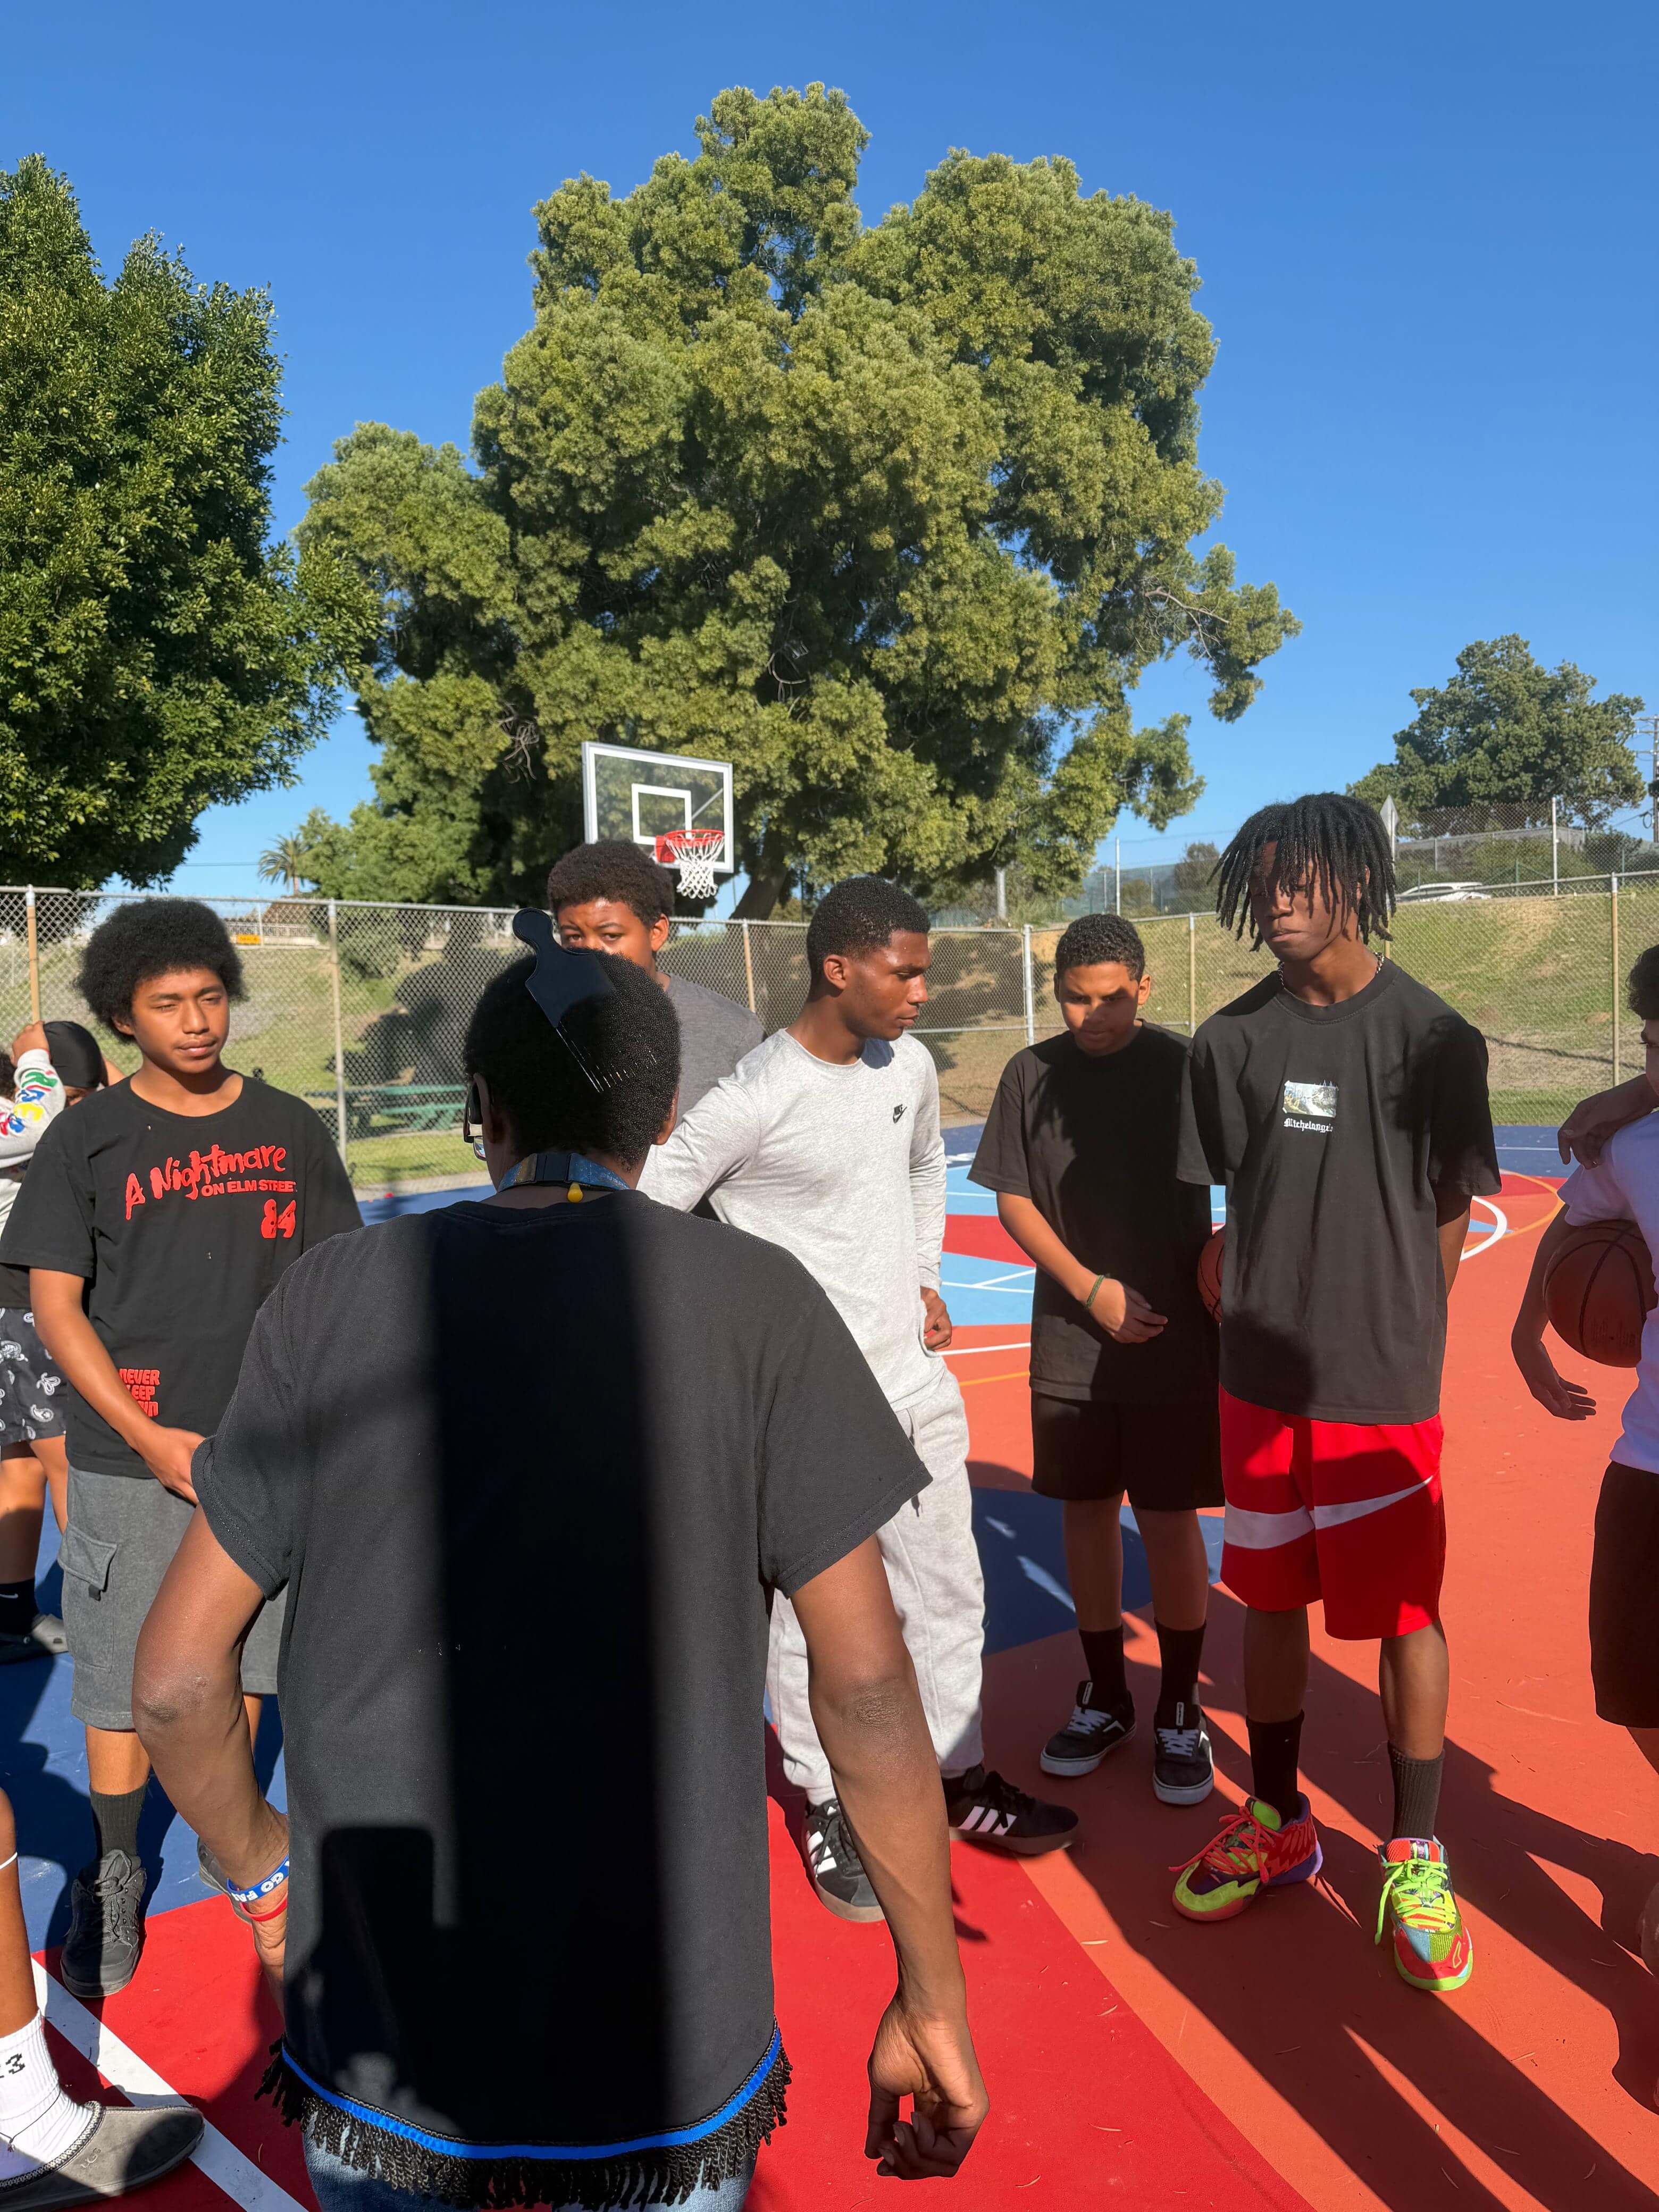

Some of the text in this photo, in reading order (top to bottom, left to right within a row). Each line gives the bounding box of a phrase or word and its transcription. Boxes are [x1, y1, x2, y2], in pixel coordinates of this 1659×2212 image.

[125, 1144, 286, 1220] A Nightmare
[201, 1179, 297, 1197] ON ELM STREE
[261, 1199, 296, 1238] 84
[119, 1368, 160, 1385] NEVER
